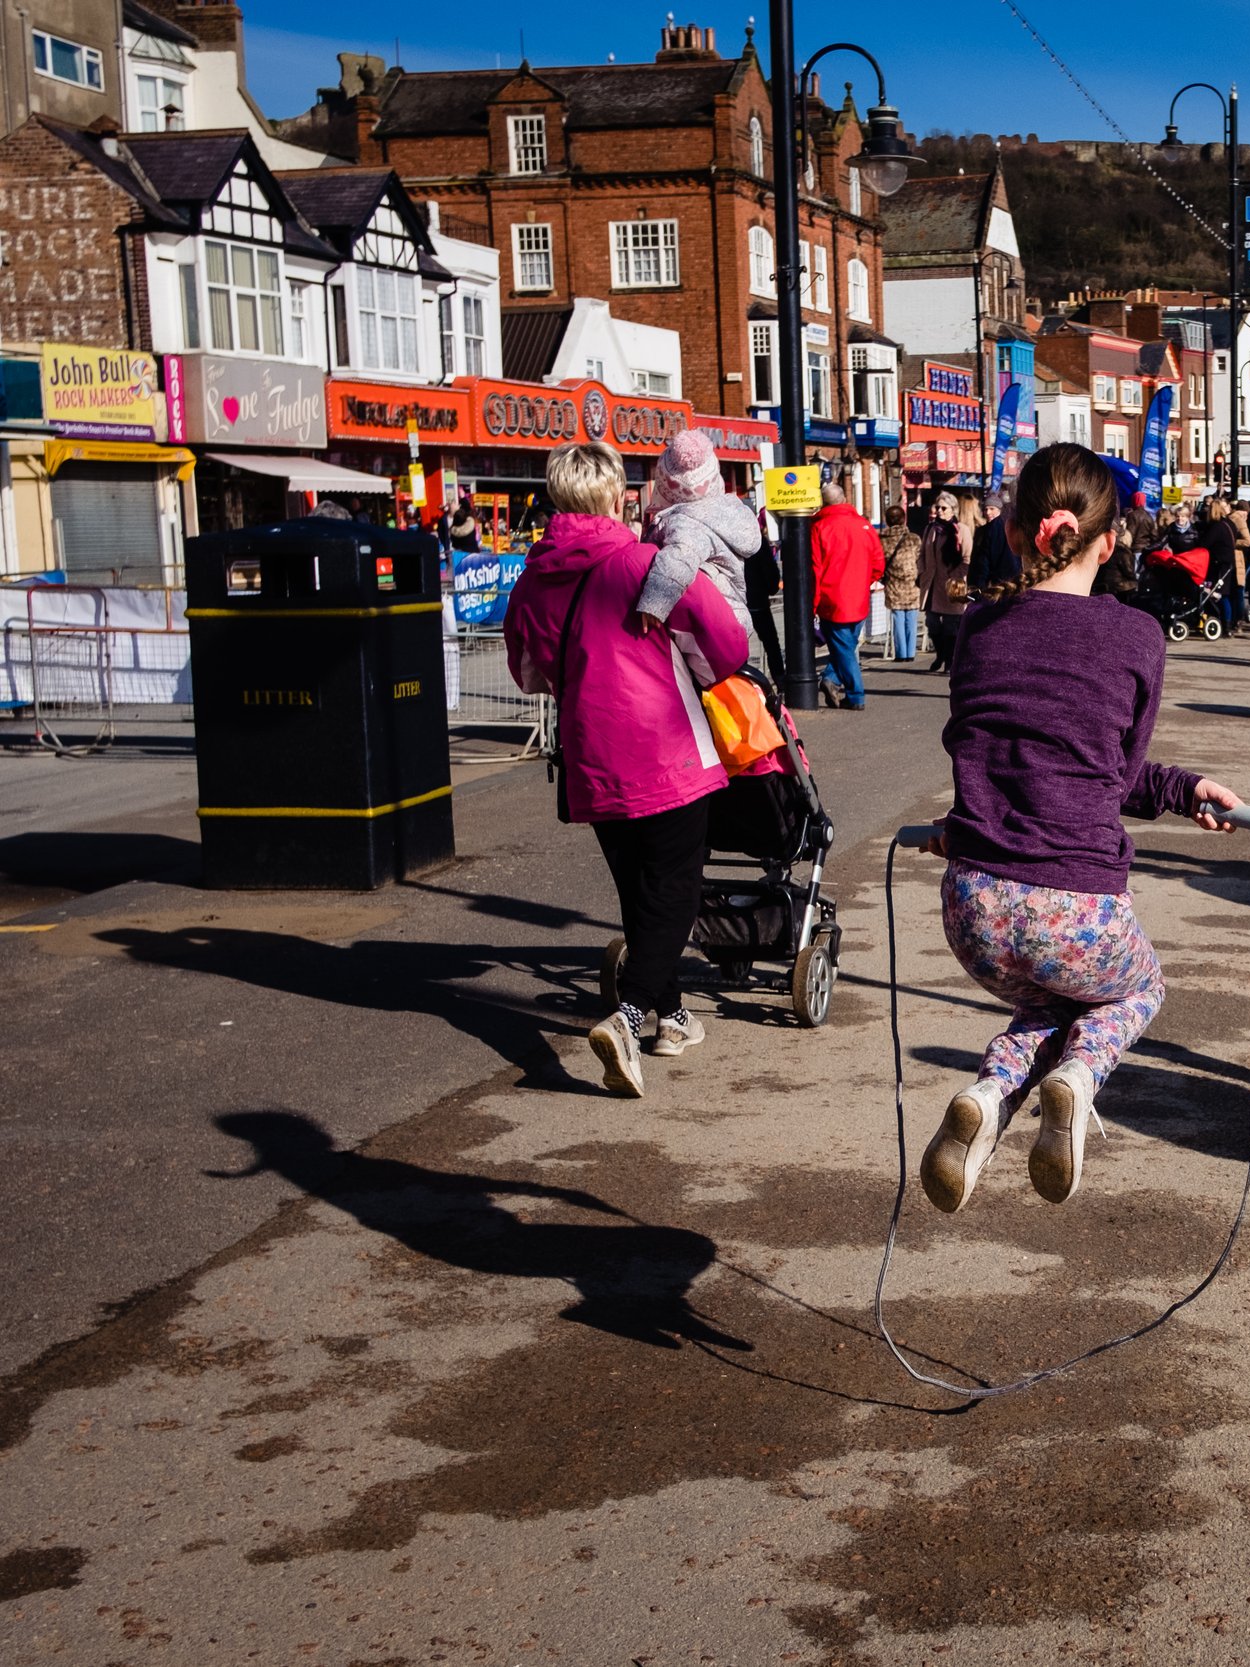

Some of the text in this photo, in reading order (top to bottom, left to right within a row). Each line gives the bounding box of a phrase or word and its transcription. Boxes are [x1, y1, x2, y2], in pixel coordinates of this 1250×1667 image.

[50, 354, 131, 386] John Bull
[929, 367, 972, 397] HENRY
[54, 386, 135, 410] ROCK MAKERS
[169, 358, 183, 441] ROCK
[267, 378, 320, 442] Fudge
[484, 392, 579, 440] SILVER
[612, 405, 688, 443] DOLLAR
[777, 488, 808, 497] Parking
[243, 689, 313, 706] LITTER
[393, 681, 421, 700] LITTER
